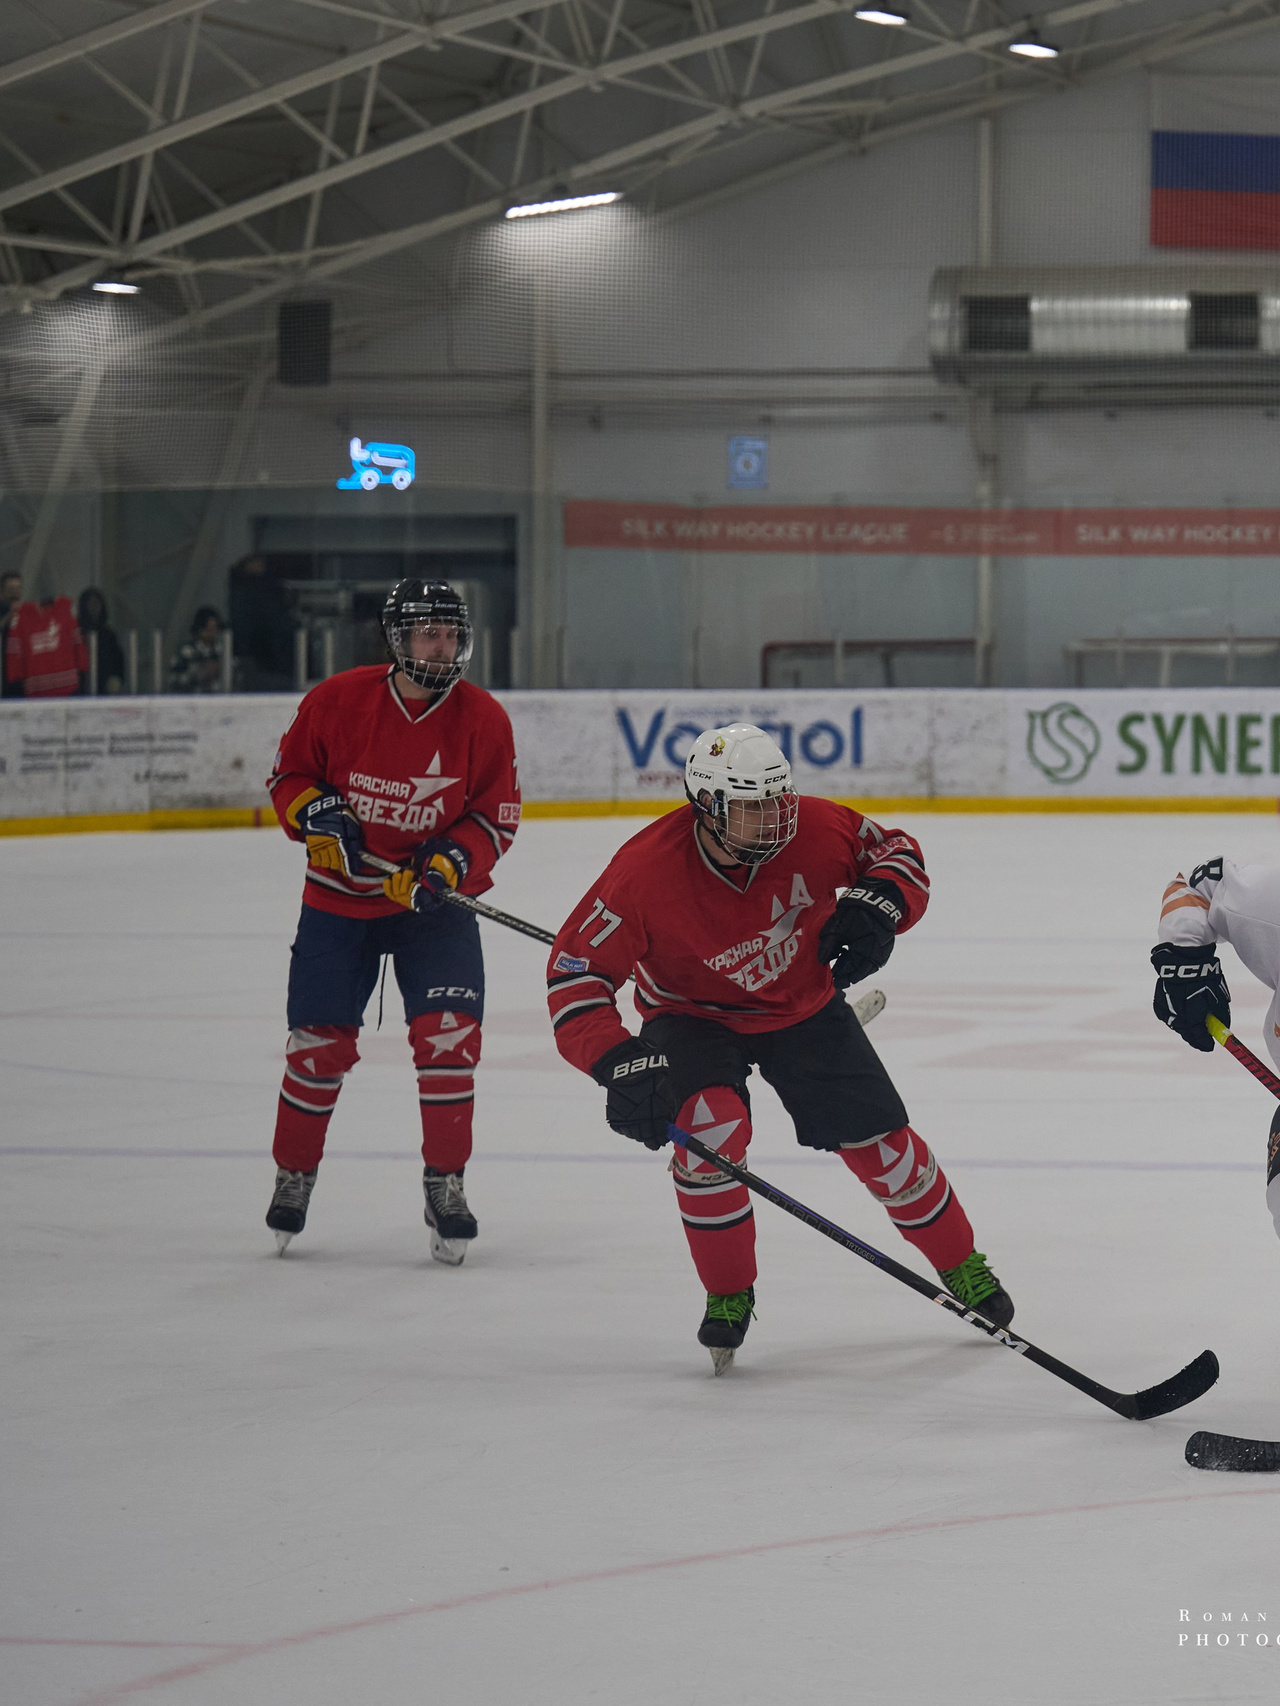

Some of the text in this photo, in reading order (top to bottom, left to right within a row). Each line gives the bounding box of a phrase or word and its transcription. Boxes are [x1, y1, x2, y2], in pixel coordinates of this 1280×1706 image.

[622, 518, 667, 539] SILK
[673, 519, 721, 540] WAY
[726, 520, 816, 542] HOCKEY
[822, 523, 909, 544] LEAGUE
[1076, 524, 1124, 543] SILK
[1129, 524, 1178, 543] WAY
[1184, 524, 1273, 543] HOCKEY
[616, 705, 863, 769] Vool
[349, 771, 411, 799] КРАСНАЯ
[692, 771, 712, 780] CCM
[764, 774, 787, 784] CCM
[578, 897, 623, 948] 77
[1160, 963, 1220, 978] CCM
[427, 987, 478, 1001] CCM
[844, 1240, 876, 1262] TRIGGER
